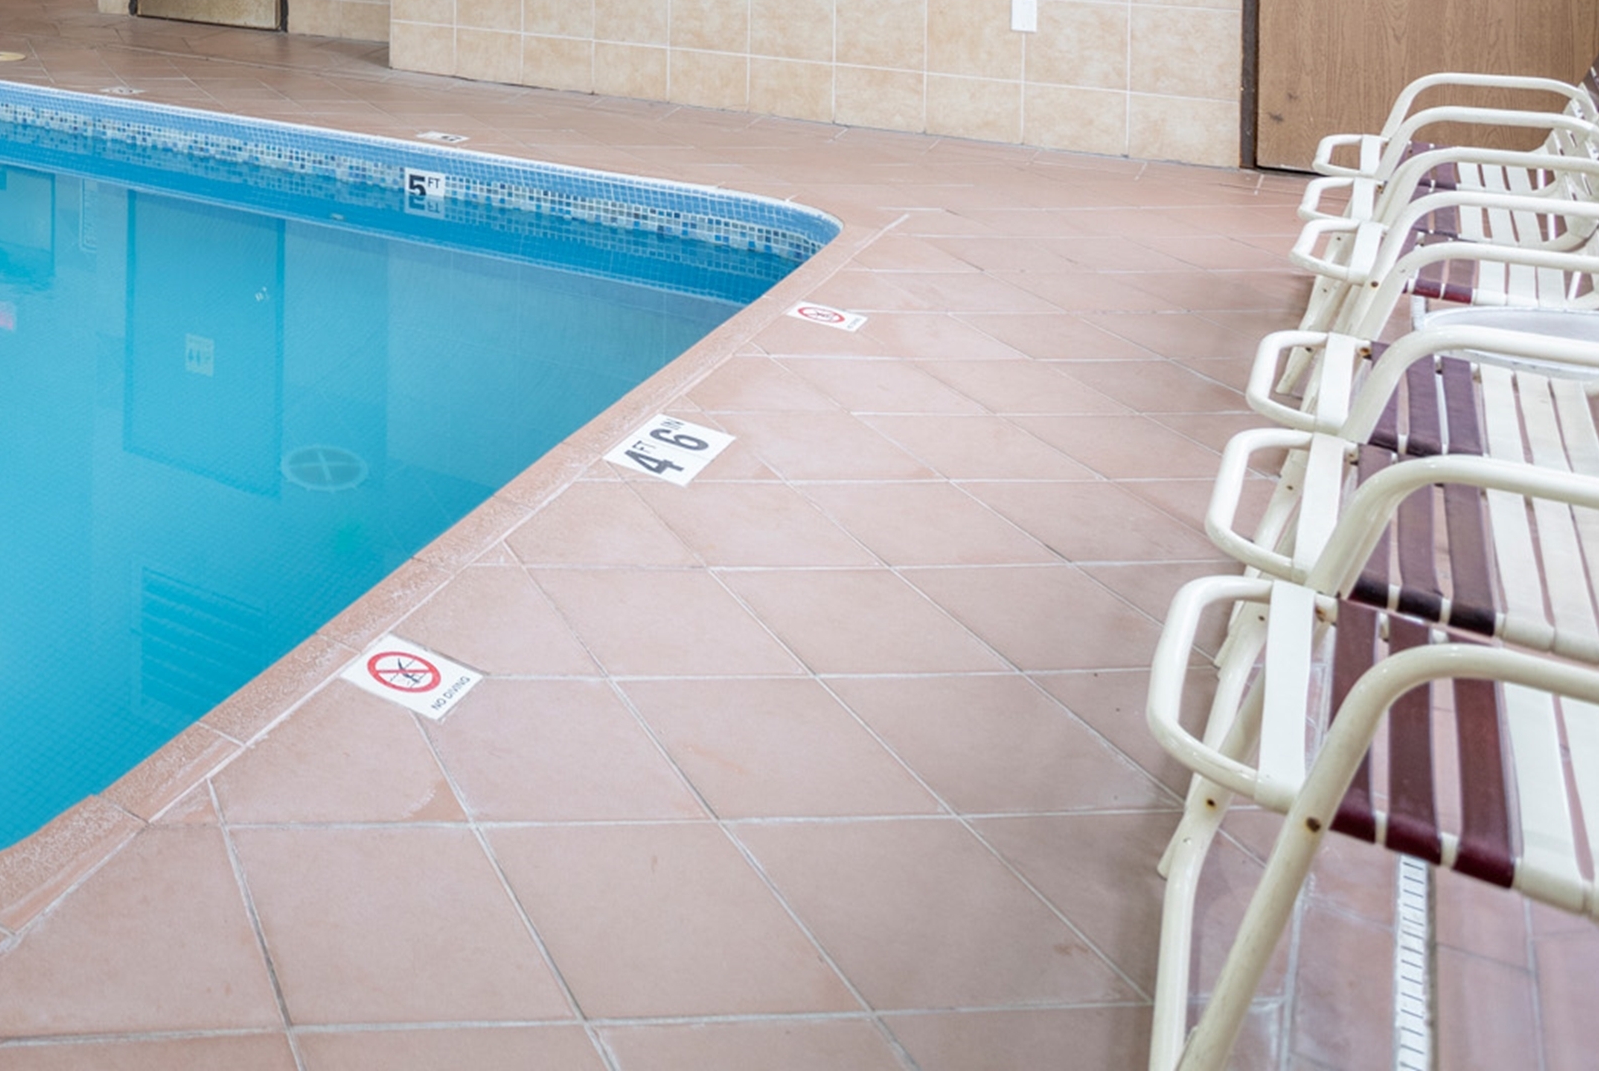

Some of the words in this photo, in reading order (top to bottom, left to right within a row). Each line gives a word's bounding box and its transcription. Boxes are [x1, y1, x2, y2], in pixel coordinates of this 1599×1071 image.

[409, 173, 427, 196] 5
[428, 176, 440, 188] FT
[431, 697, 447, 710] NO
[443, 675, 471, 700] DIVING
